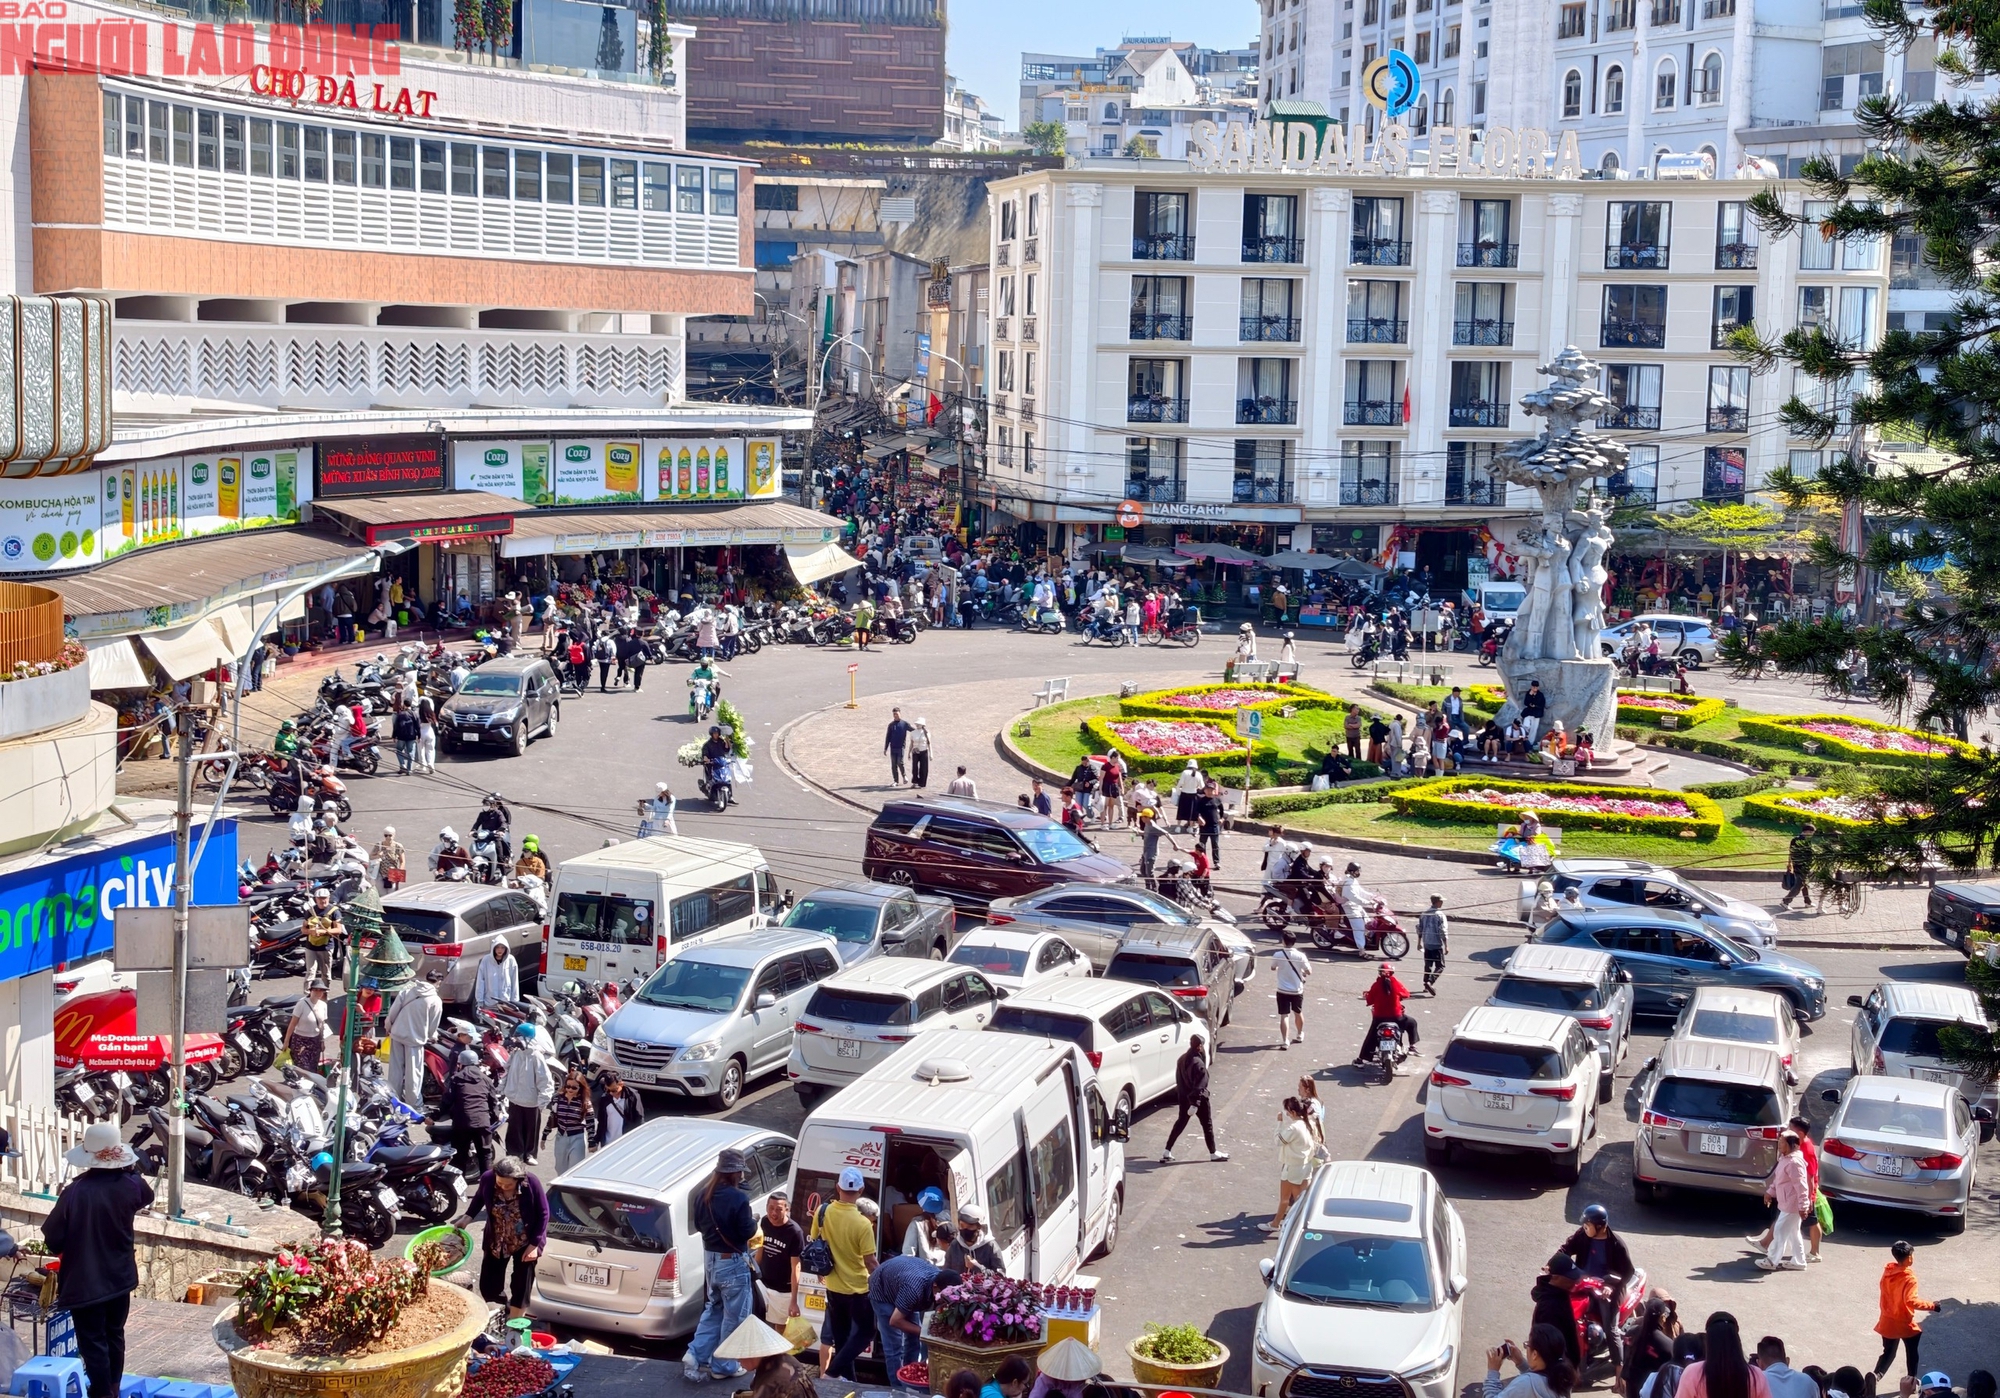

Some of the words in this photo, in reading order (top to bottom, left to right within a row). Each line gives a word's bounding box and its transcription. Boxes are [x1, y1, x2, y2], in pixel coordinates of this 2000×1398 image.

[250, 64, 306, 107] CHỢ
[315, 72, 359, 108] ĐÀ
[372, 83, 437, 121] LẠT
[1190, 120, 1408, 175] SANDALS
[1428, 126, 1583, 179] FLORA
[383, 449, 415, 466] QUANG
[416, 449, 437, 462] VINH
[486, 452, 507, 463] Cozy
[567, 447, 589, 460] Cozy
[611, 451, 630, 462] Cozy
[193, 466, 209, 480] Cozy
[252, 462, 269, 474] Cozy
[0, 499, 62, 509] KOMBUCHA
[64, 495, 81, 507] HÒA
[82, 495, 95, 504] TAN
[1152, 503, 1226, 515] L'ANGFARM
[581, 942, 621, 953] 65B-018.20
[123, 1043, 148, 1052] bạn!
[88, 1058, 124, 1066] McDonald's
[124, 1058, 136, 1067] Chợ
[147, 1058, 156, 1067] Lạt
[1708, 1135, 1720, 1144] 60A
[1876, 1165, 1901, 1175] 390.62
[585, 1268, 599, 1276] 70A
[579, 1275, 605, 1285] 481.58
